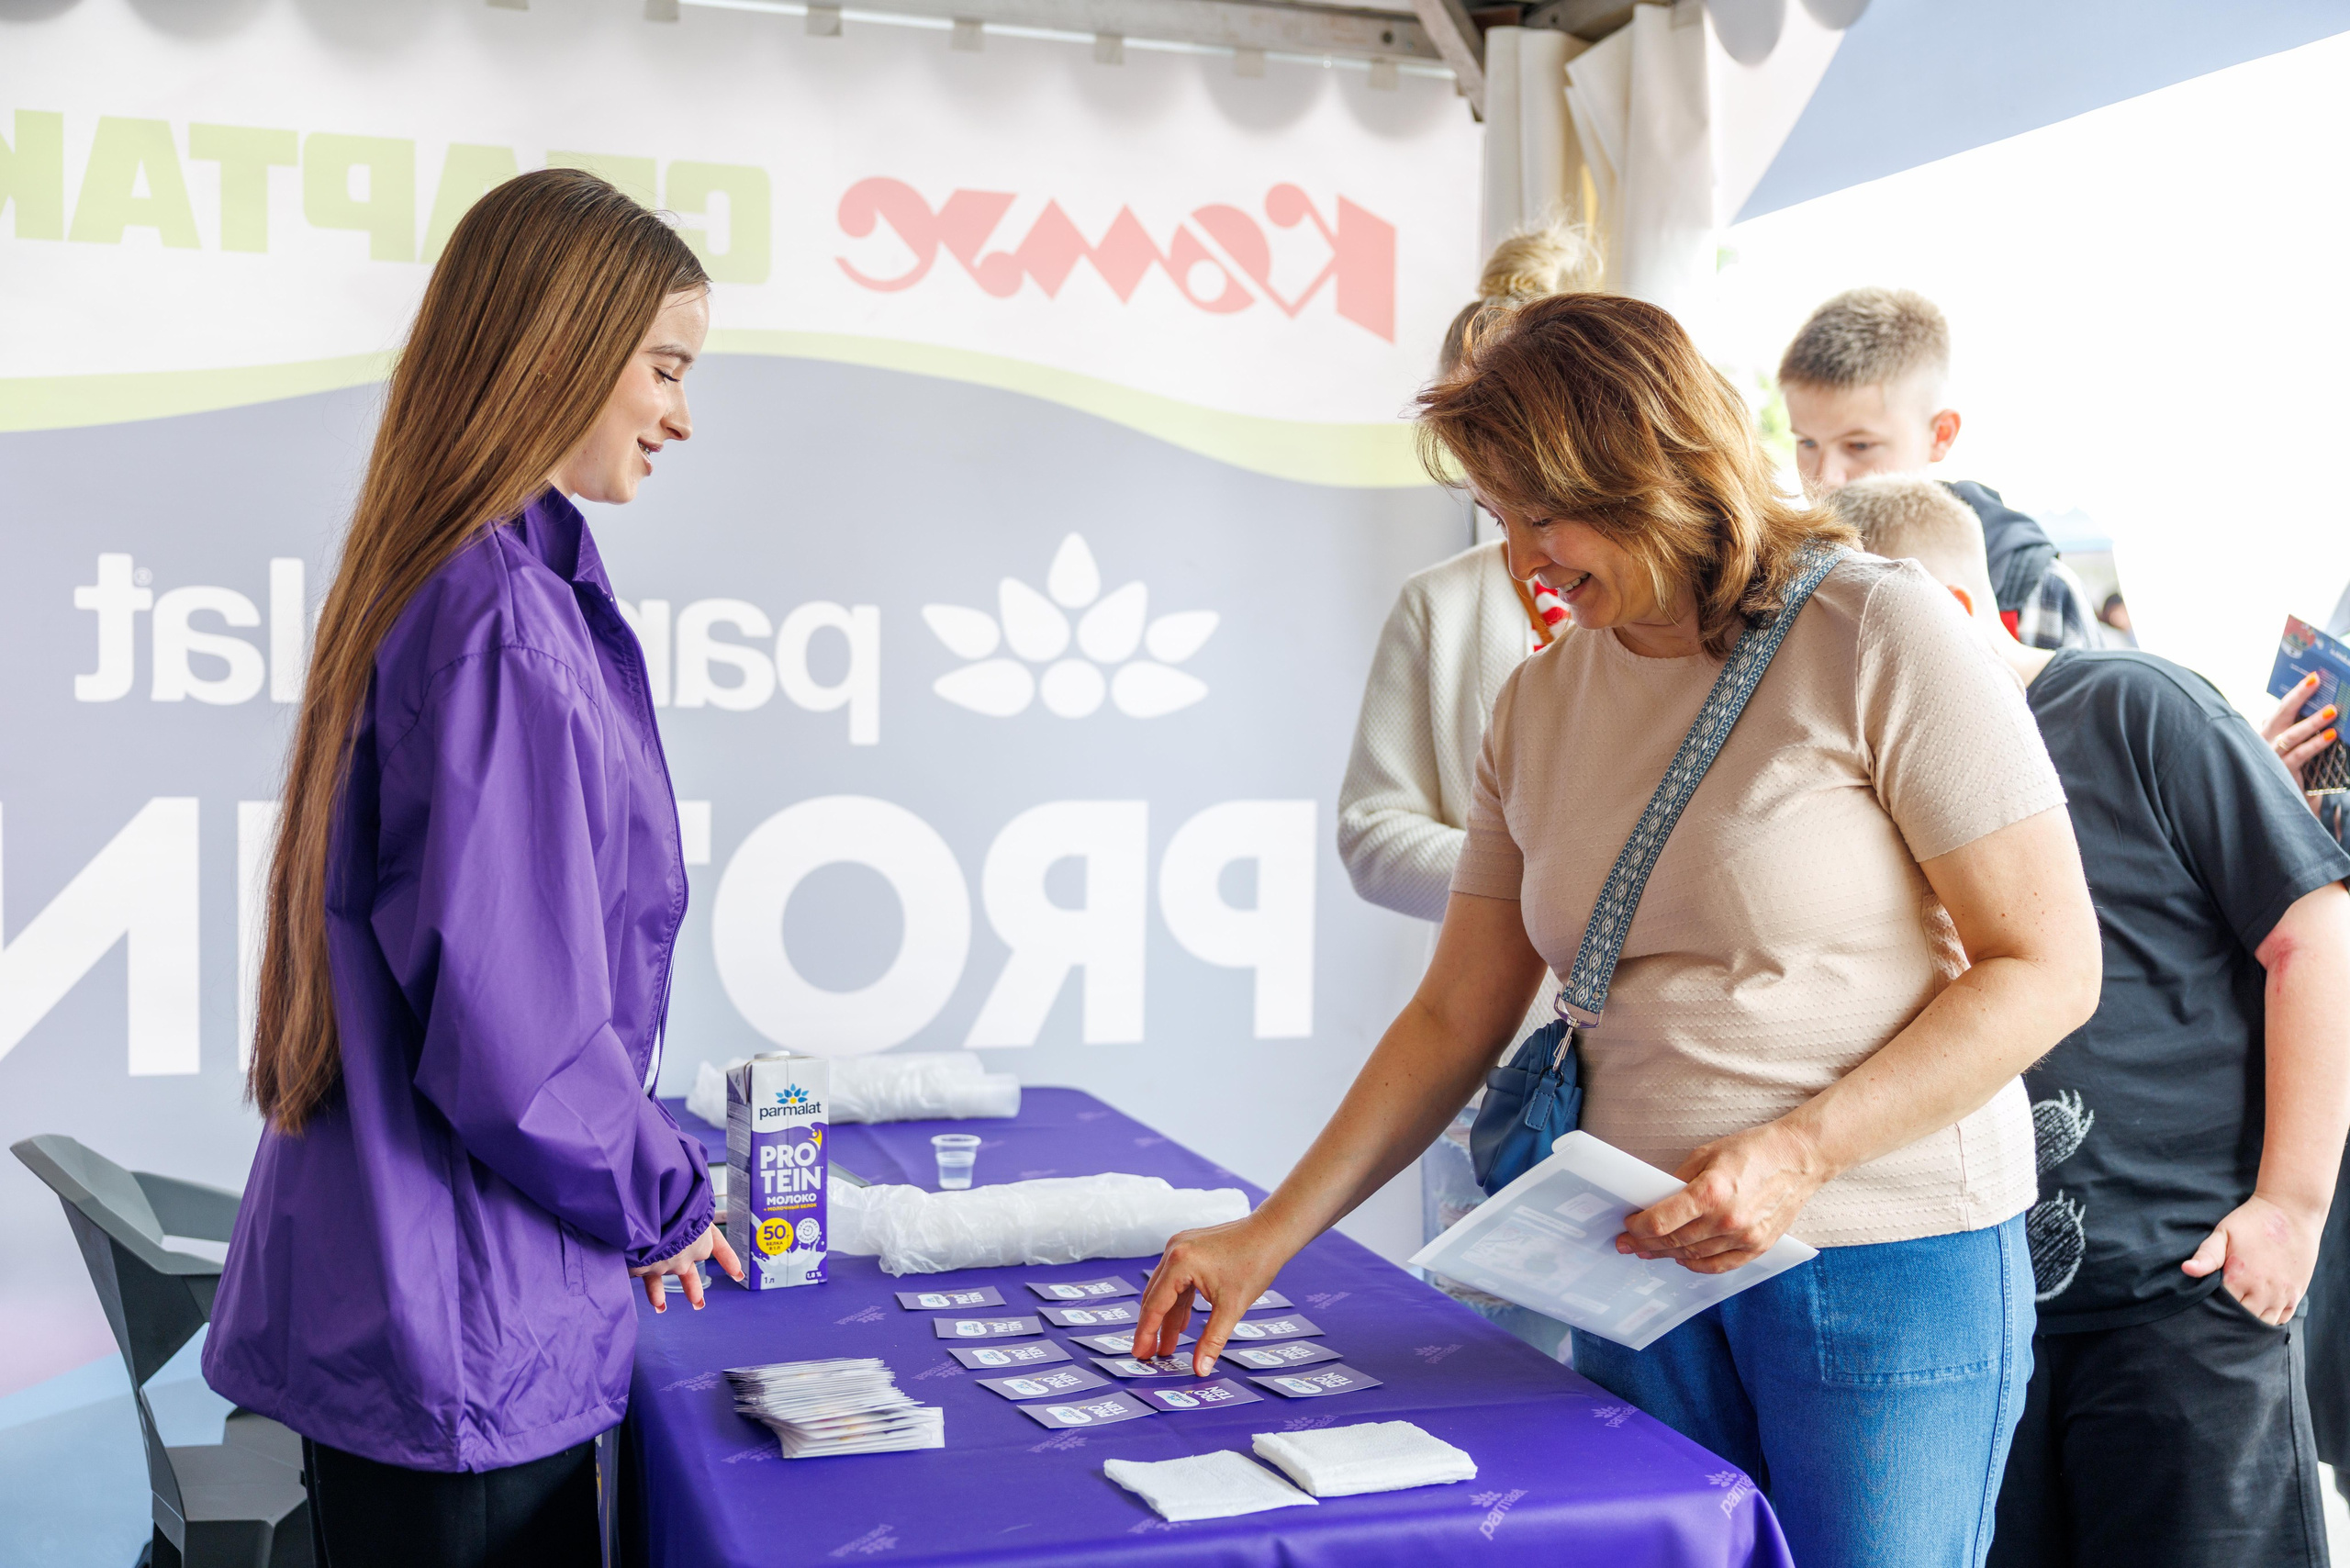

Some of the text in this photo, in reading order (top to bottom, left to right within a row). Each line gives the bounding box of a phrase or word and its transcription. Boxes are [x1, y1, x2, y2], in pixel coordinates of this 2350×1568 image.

[759, 1101, 822, 1120] parmalat
[760, 1142, 816, 1170] PRO
[760, 1166, 822, 1193] TEIN
[767, 1193, 817, 1205] МОЛОКО
[764, 1225, 786, 1240] 50
[1098, 1310, 1118, 1321] PRO
[993, 1322, 1009, 1333] PRO
[1264, 1324, 1288, 1334] PRO
[1011, 1349, 1034, 1360] PRO
[1276, 1350, 1302, 1360] PRO
[1157, 1361, 1179, 1372] PRO
[1042, 1377, 1069, 1388] PRO
[1312, 1377, 1341, 1388] PRO
[1193, 1390, 1222, 1402] PRO
[1088, 1406, 1113, 1417] PRO
[1479, 1488, 1529, 1541] parmalat
